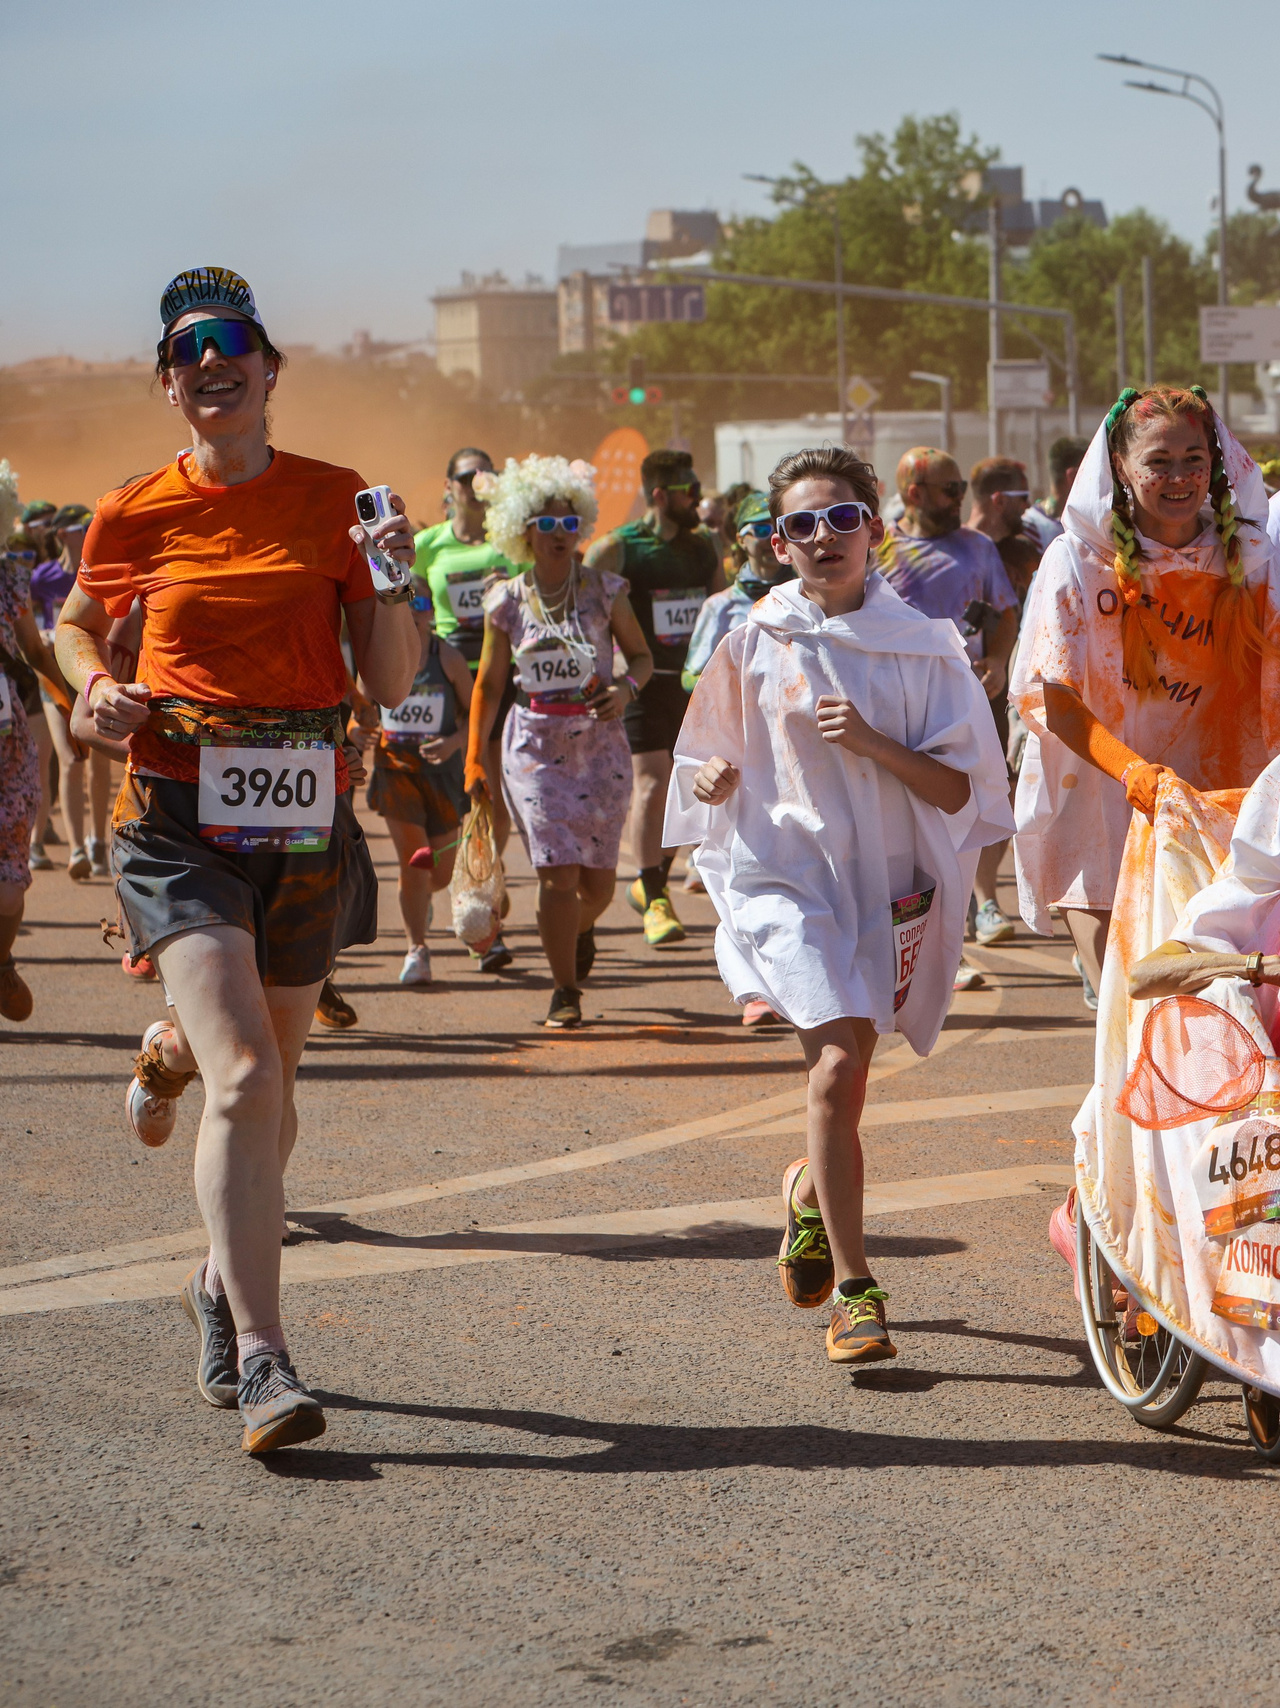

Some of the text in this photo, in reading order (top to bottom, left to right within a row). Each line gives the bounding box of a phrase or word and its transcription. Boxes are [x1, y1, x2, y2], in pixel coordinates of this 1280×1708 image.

[665, 607, 698, 626] 1417
[531, 659, 580, 682] 1948
[389, 704, 433, 724] 4696
[283, 740, 332, 750] 2026
[220, 767, 317, 808] 3960
